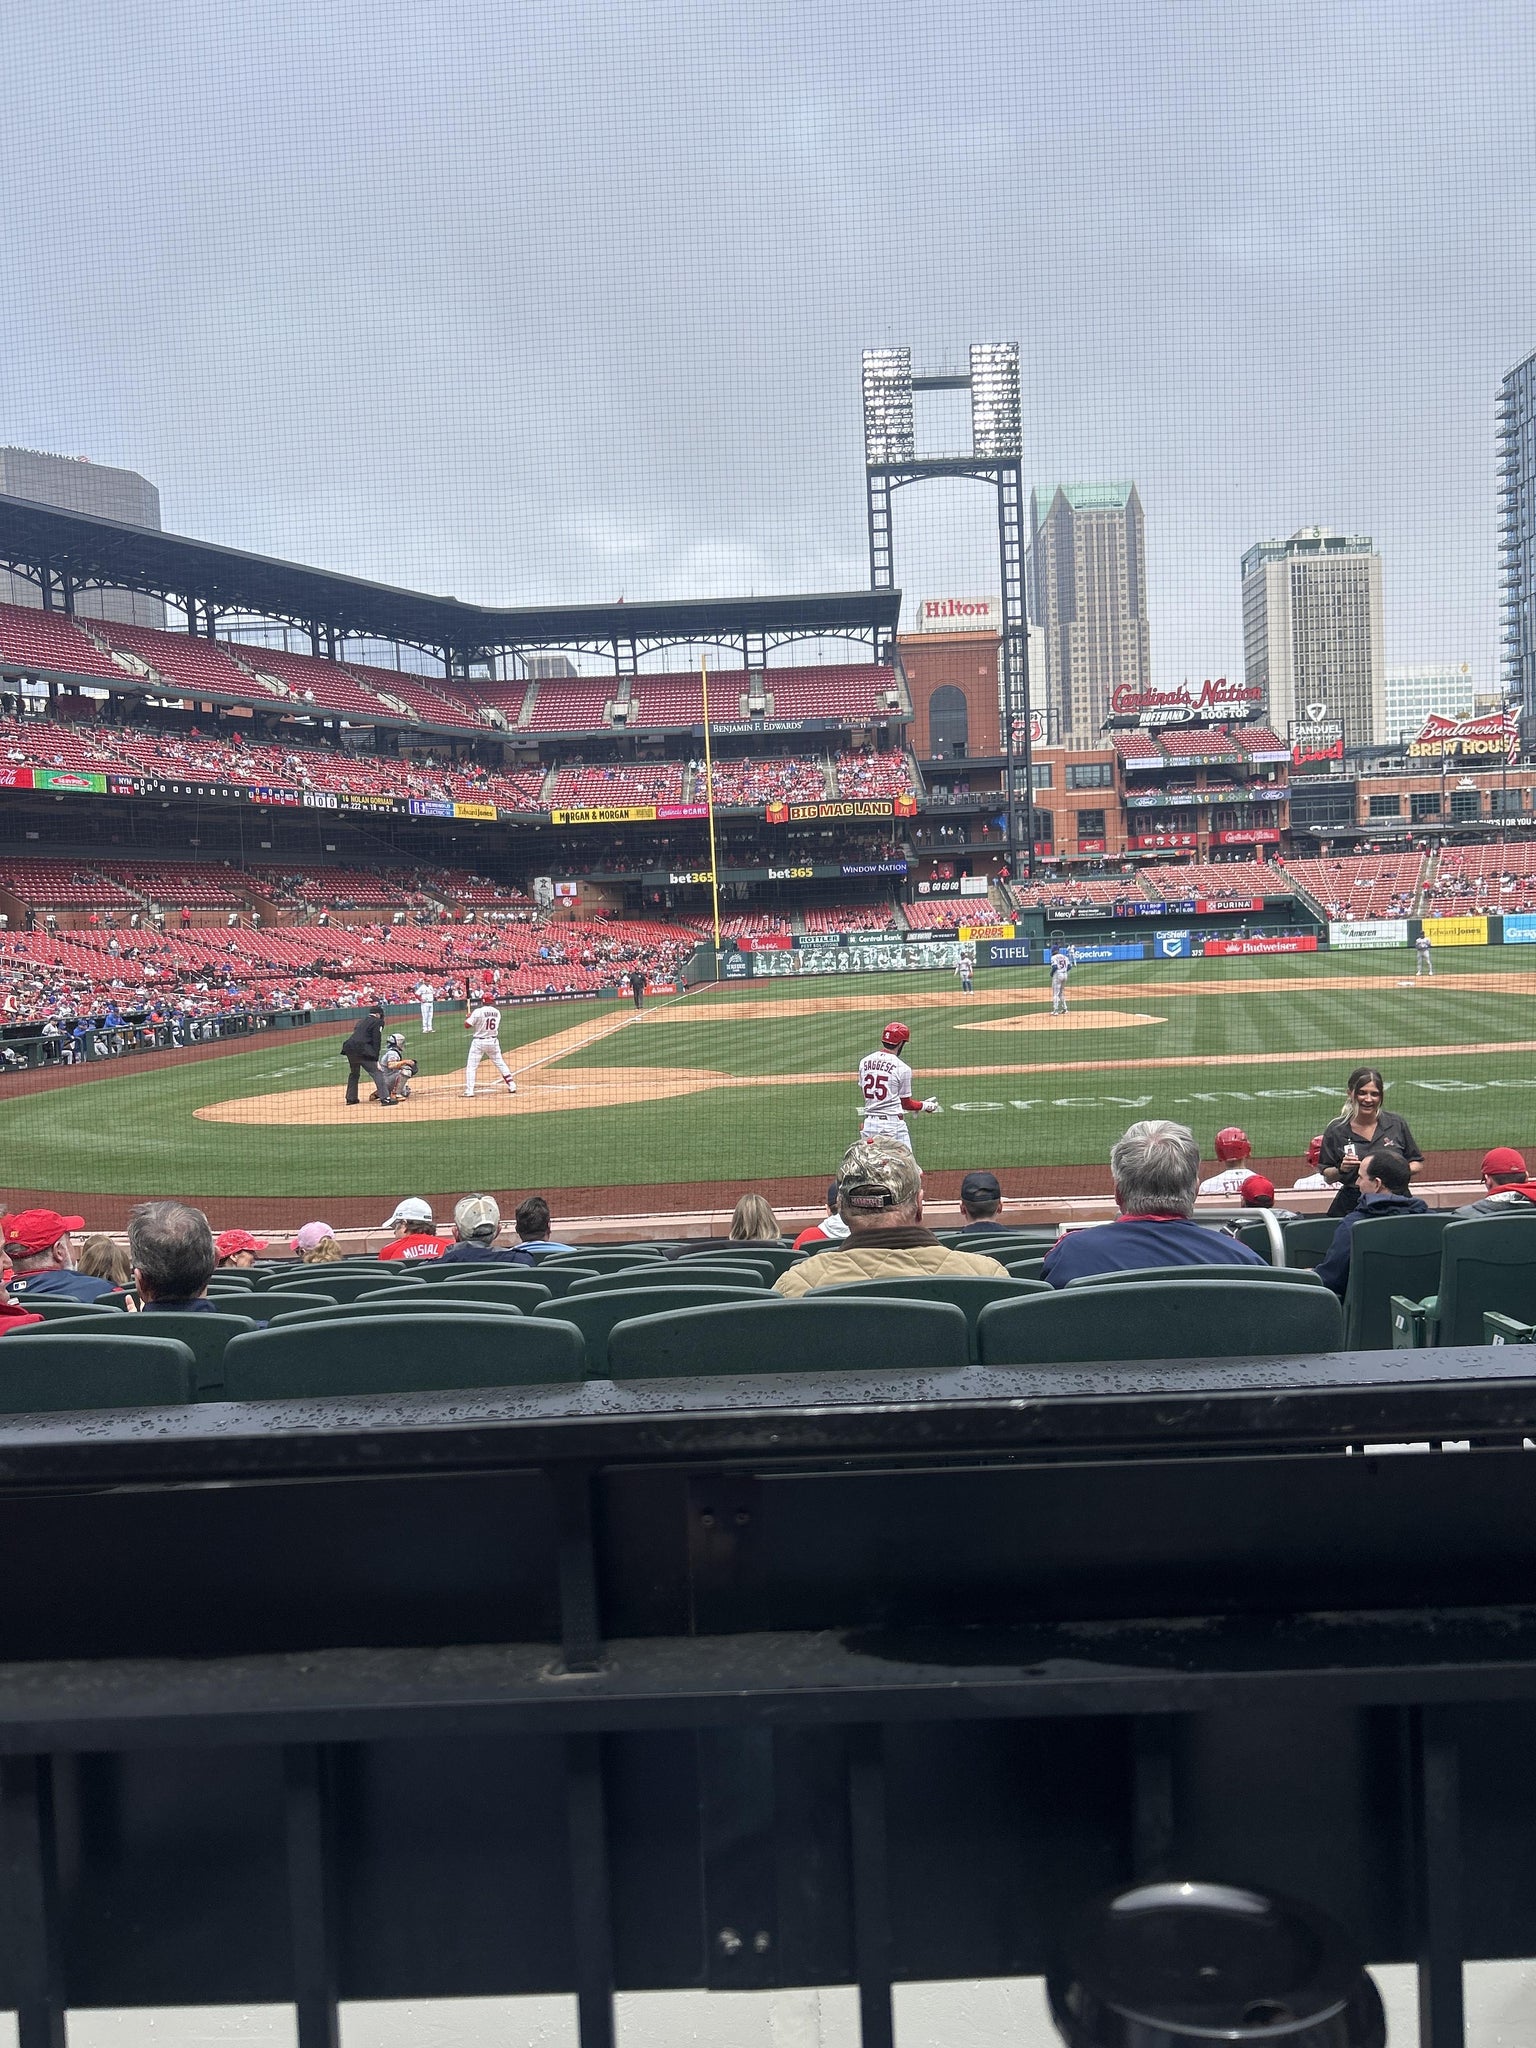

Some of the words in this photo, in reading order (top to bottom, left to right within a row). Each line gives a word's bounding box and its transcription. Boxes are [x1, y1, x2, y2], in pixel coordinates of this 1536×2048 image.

[925, 599, 989, 618] Hilton
[1112, 684, 1192, 713] Cardinals
[1191, 678, 1262, 709] Nation
[1139, 710, 1186, 722] HOFFMANN
[1201, 709, 1250, 720] ROOFTOP
[713, 723, 753, 733] BENJAMIN
[763, 721, 801, 731] EDWARDS
[1293, 724, 1343, 735] FANDUEL
[1415, 720, 1504, 740] Budweise
[1409, 740, 1459, 757] BREW
[0, 768, 17, 785] ola
[118, 777, 133, 785] NYM
[351, 795, 370, 804] NOLAN
[370, 797, 394, 806] GORMAN
[592, 810, 598, 820] &
[600, 809, 630, 820] MORGAN
[790, 806, 818, 820] BIG
[819, 802, 855, 817] MAC
[855, 802, 893, 816] LAND
[1516, 817, 1532, 826] YOU
[768, 867, 813, 880] bet365
[842, 864, 877, 874] WINDOW
[878, 863, 907, 873] NATION
[669, 871, 714, 885] bet365
[1216, 902, 1251, 910] PURINA
[1054, 911, 1071, 919] Mercy
[970, 927, 1004, 937] DOBBS
[1156, 930, 1187, 939] CarShield
[1348, 929, 1377, 938] Ameren
[1429, 927, 1457, 937] Edward
[1457, 927, 1481, 936] Jones
[800, 934, 839, 943] ROTTLER
[858, 935, 883, 943] Central
[1243, 941, 1298, 953] Budweiser
[990, 946, 1029, 960] STIFEL
[1075, 950, 1109, 960] Spectrum
[485, 1017, 496, 1030] 16
[863, 1060, 897, 1075] SAGGESE
[863, 1073, 889, 1101] 25
[402, 1243, 439, 1259] MUSIAL
